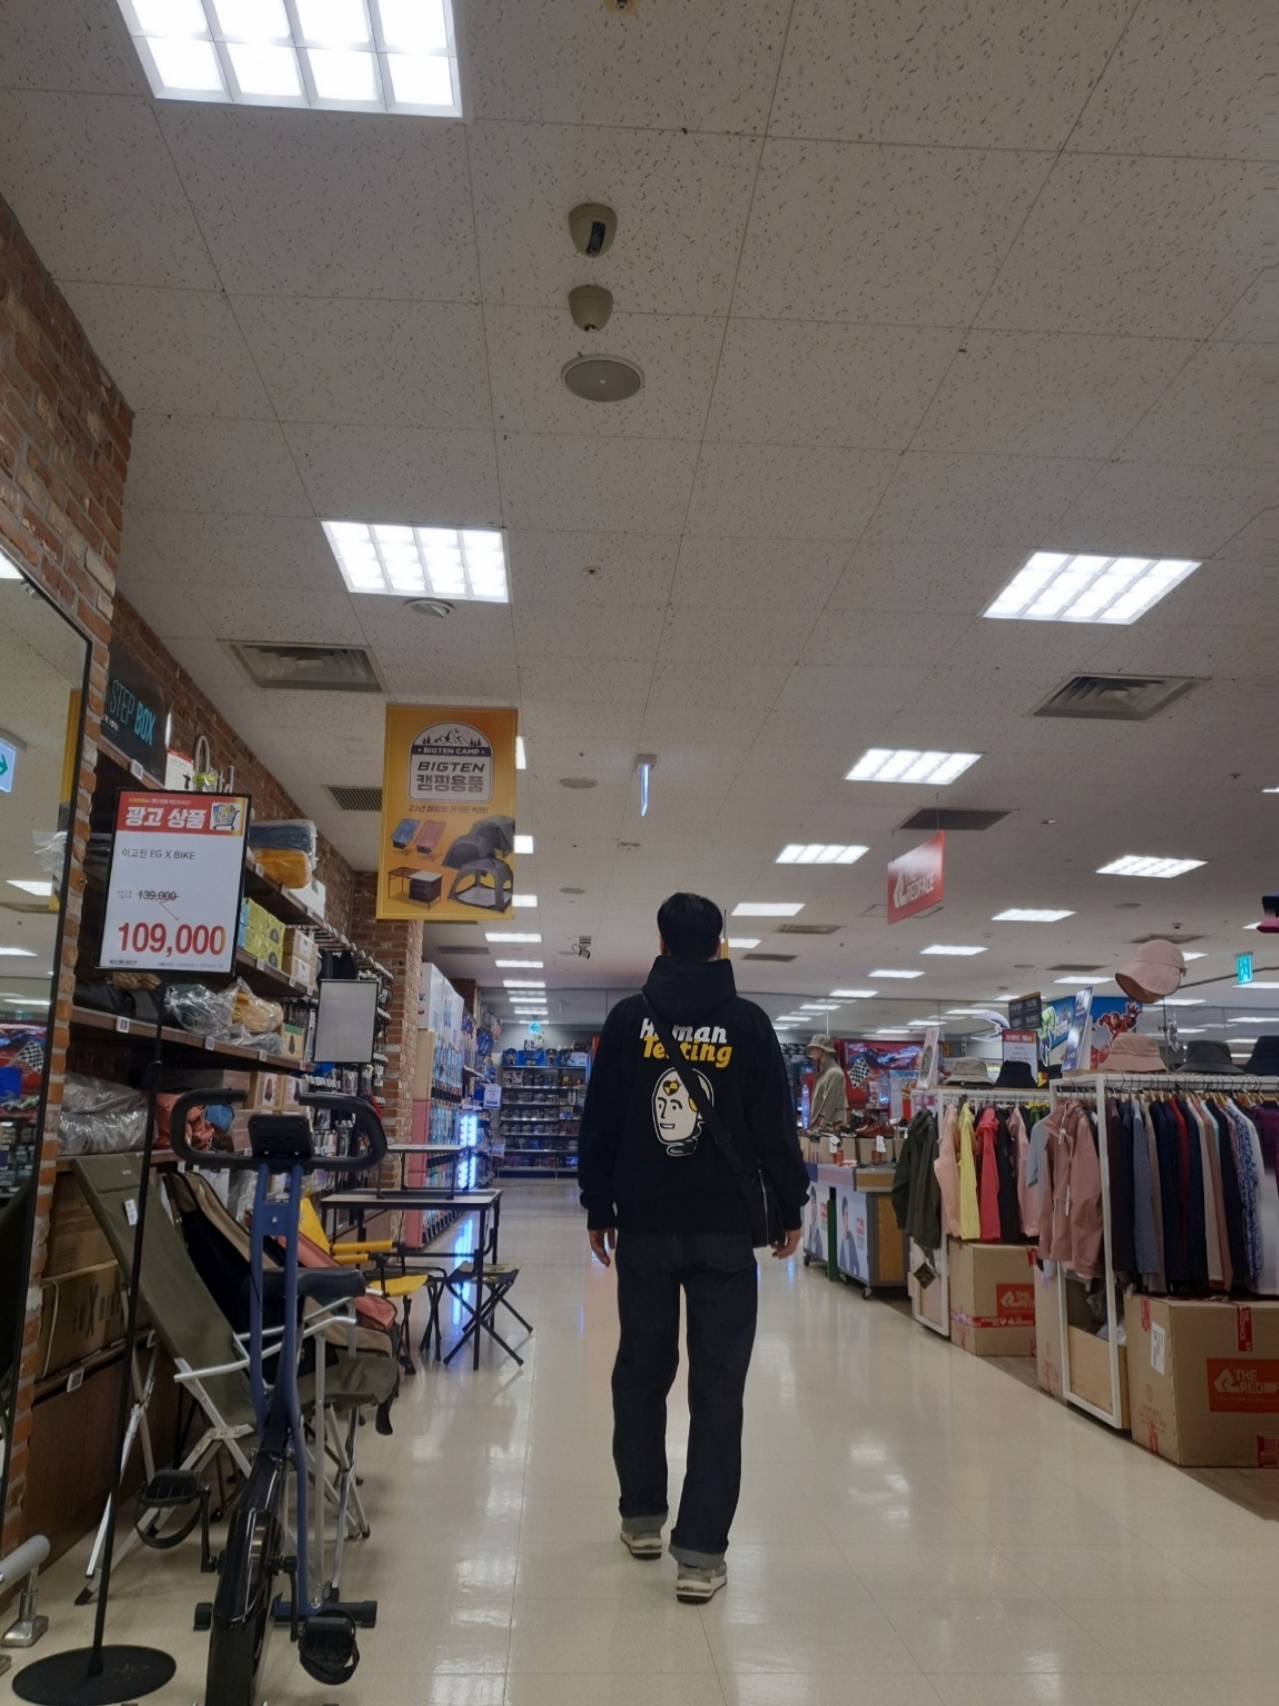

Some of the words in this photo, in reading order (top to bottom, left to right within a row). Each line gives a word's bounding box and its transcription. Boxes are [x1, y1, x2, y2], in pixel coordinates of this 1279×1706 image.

[109, 679, 136, 725] STEP
[133, 700, 156, 747] BOX
[423, 747, 454, 755] BIGTEN
[455, 748, 480, 756] CAMP
[417, 761, 485, 773] BIGTEN
[417, 774, 484, 793] 캠핑용품
[125, 806, 165, 827] 광고
[168, 808, 207, 829] 상품
[121, 848, 148, 859] 이고진
[150, 849, 162, 859] EG
[164, 850, 171, 859] X
[174, 850, 195, 860] BIKE
[138, 890, 177, 901] 139,000
[118, 922, 226, 958] 109,000
[639, 1018, 728, 1043] Hman
[643, 1035, 733, 1068] Teting
[1234, 1369, 1258, 1382] THE
